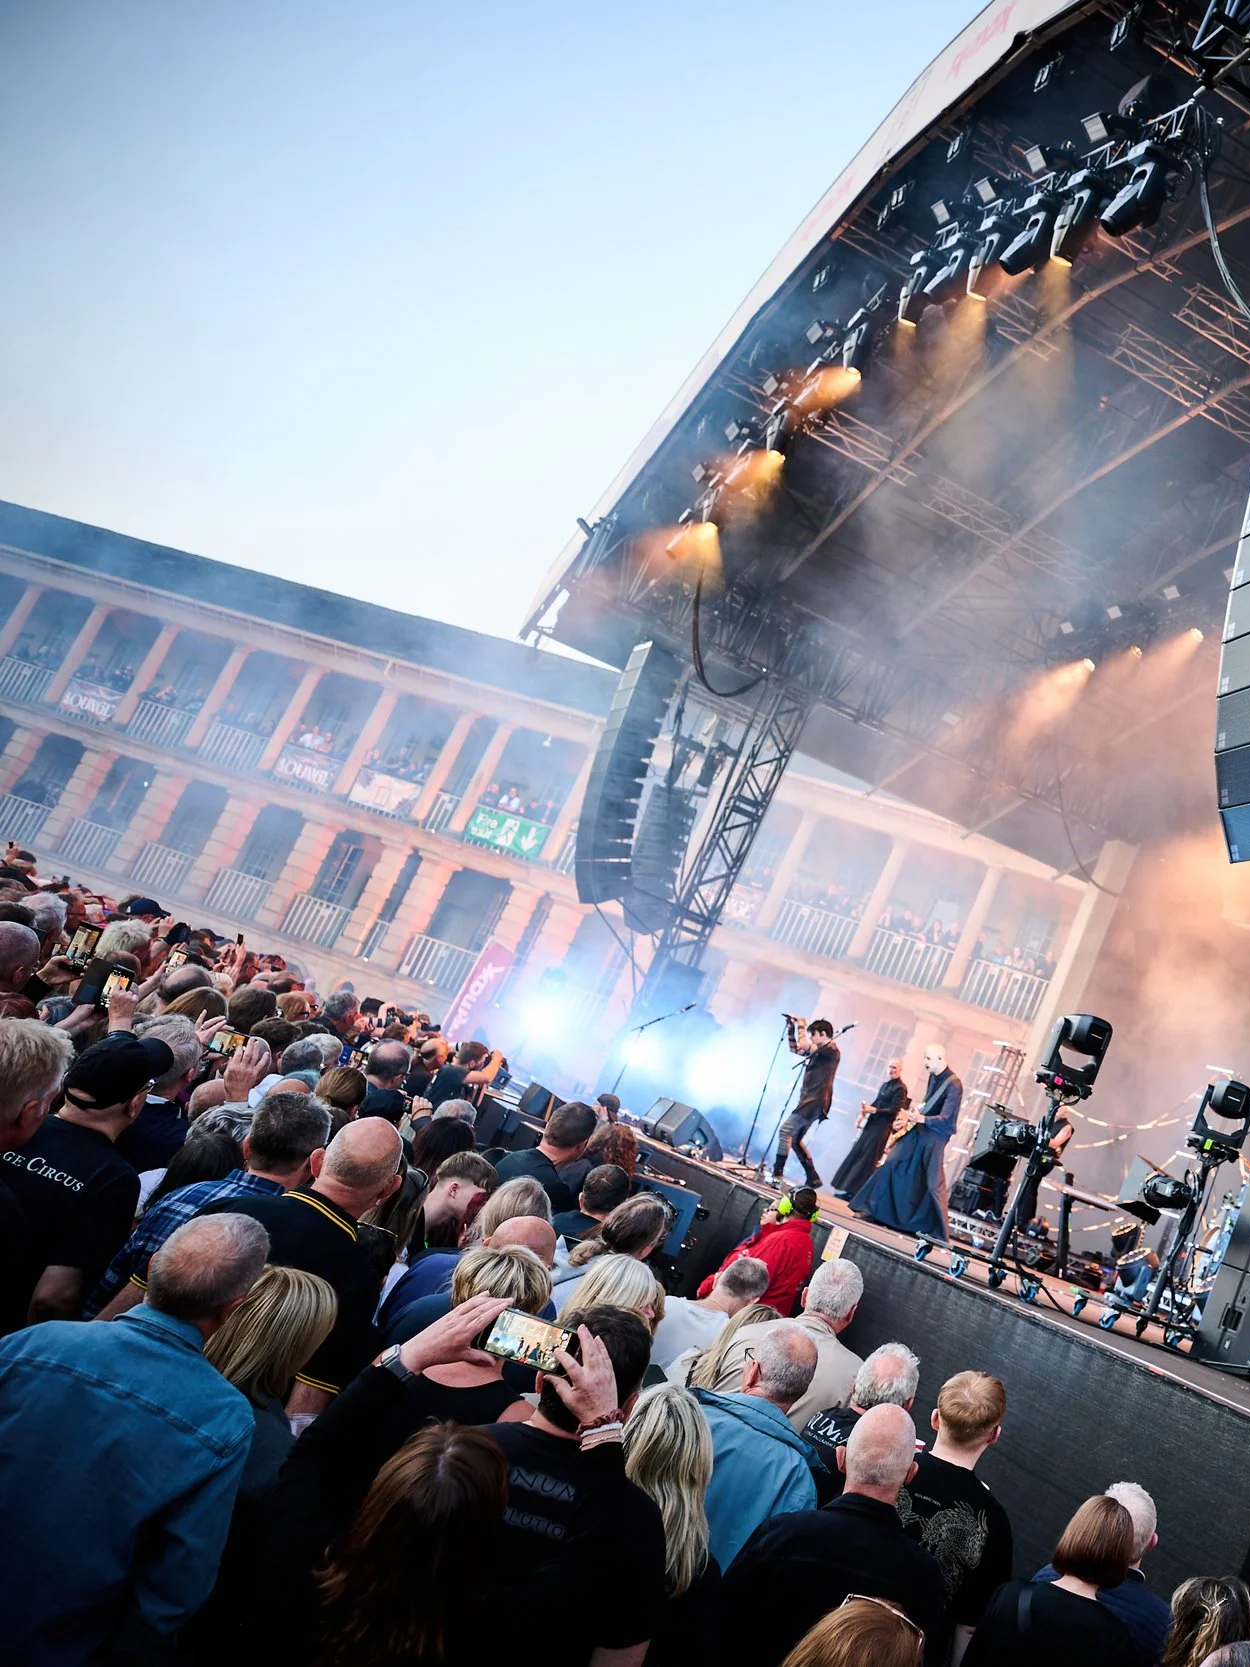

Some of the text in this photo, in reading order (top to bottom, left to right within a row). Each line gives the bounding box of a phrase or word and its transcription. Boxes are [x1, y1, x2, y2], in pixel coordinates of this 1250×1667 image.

[476, 812, 499, 830] Fire
[470, 826, 493, 840] exit
[0, 1151, 26, 1167] GE
[503, 1508, 564, 1537] LUTIO
